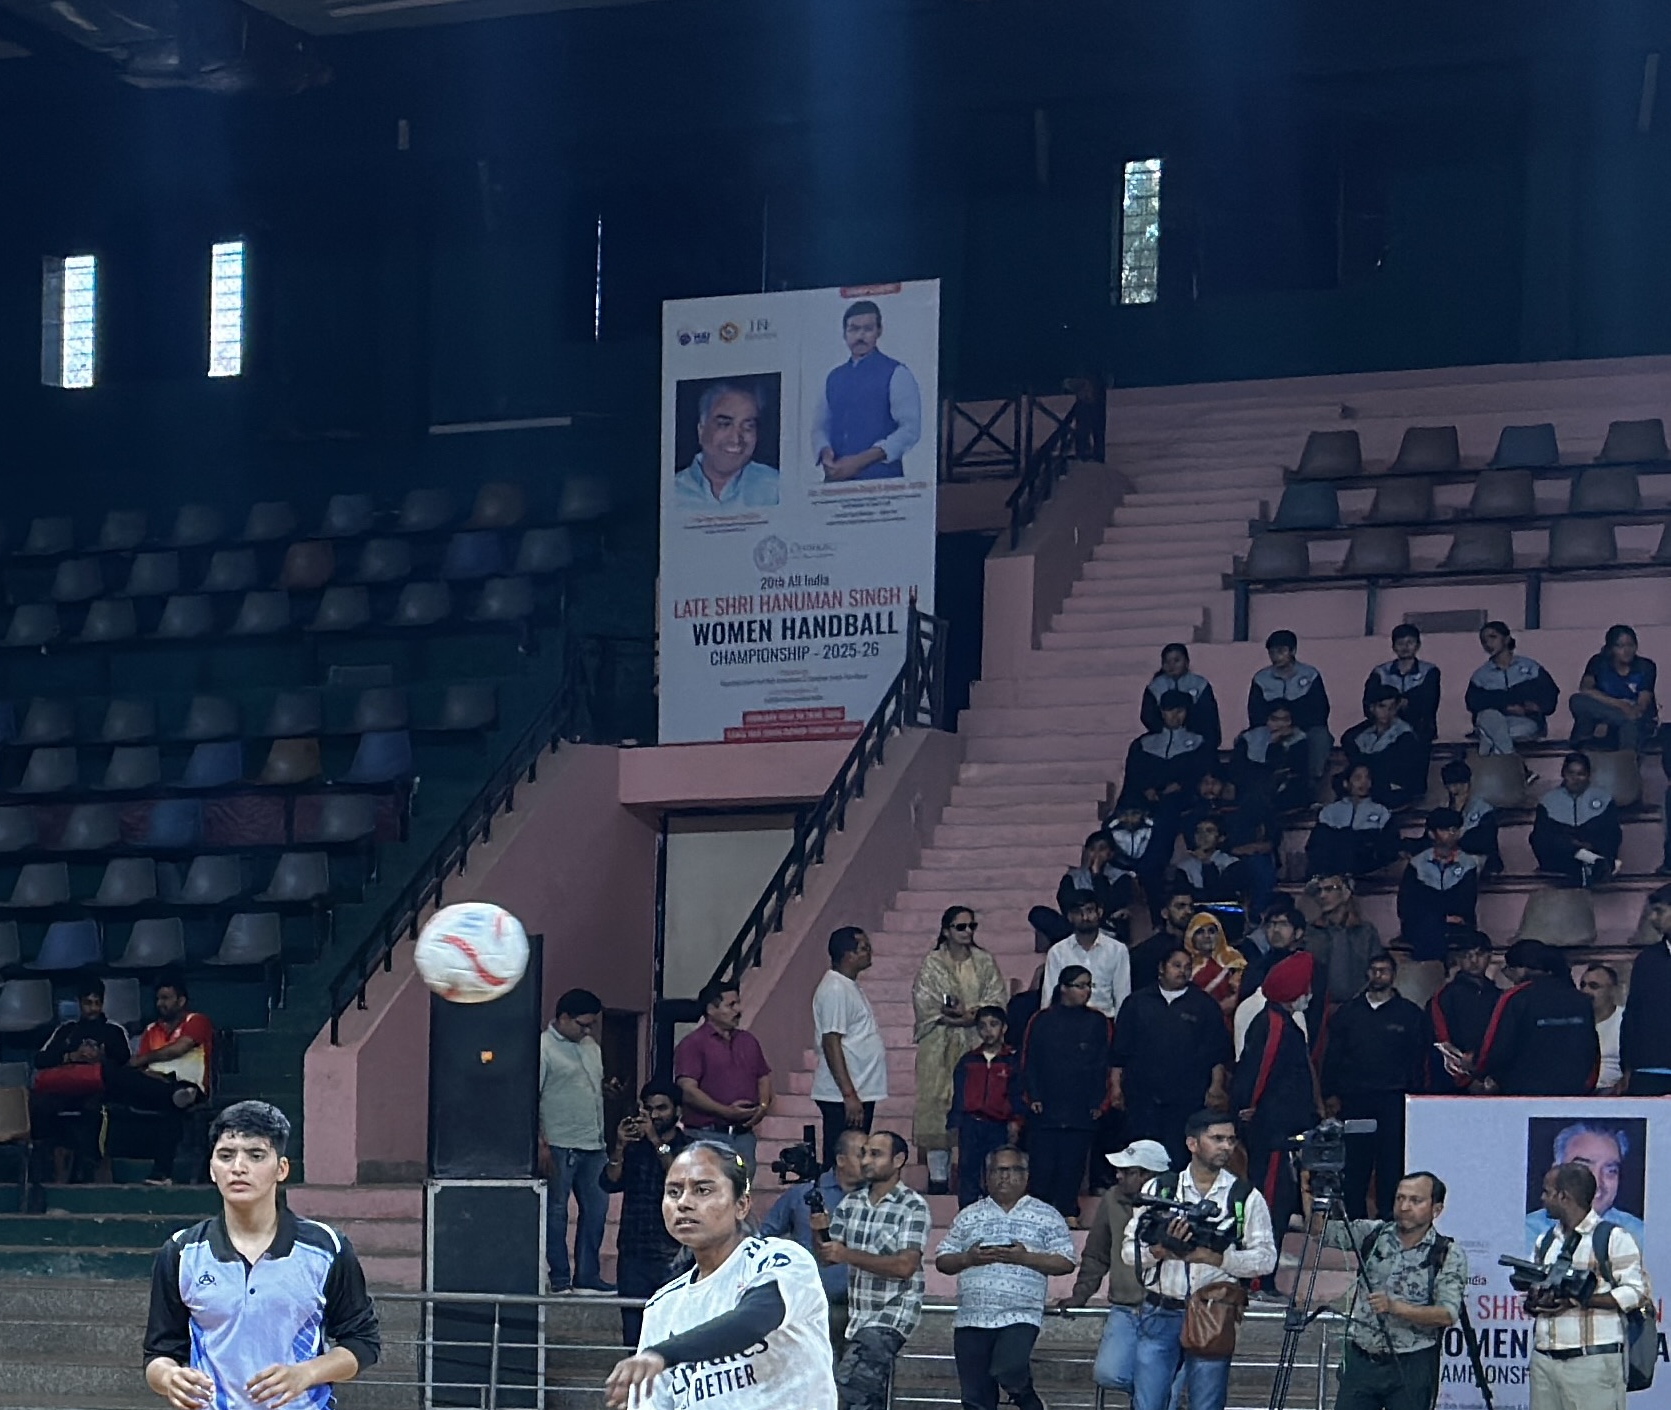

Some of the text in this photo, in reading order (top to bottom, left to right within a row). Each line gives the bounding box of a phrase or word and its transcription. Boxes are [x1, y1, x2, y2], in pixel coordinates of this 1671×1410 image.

[760, 574, 829, 590] 20th All India
[674, 598, 709, 619] LATE
[715, 595, 754, 616] SHRI
[760, 590, 843, 614] HANUMAN
[849, 586, 901, 607] SINGH
[692, 611, 898, 646] WOMEN HANDBALL
[710, 646, 810, 666] CHAMPIONSHIP
[823, 641, 879, 660] 2025-26
[694, 1364, 758, 1402] BETTER
